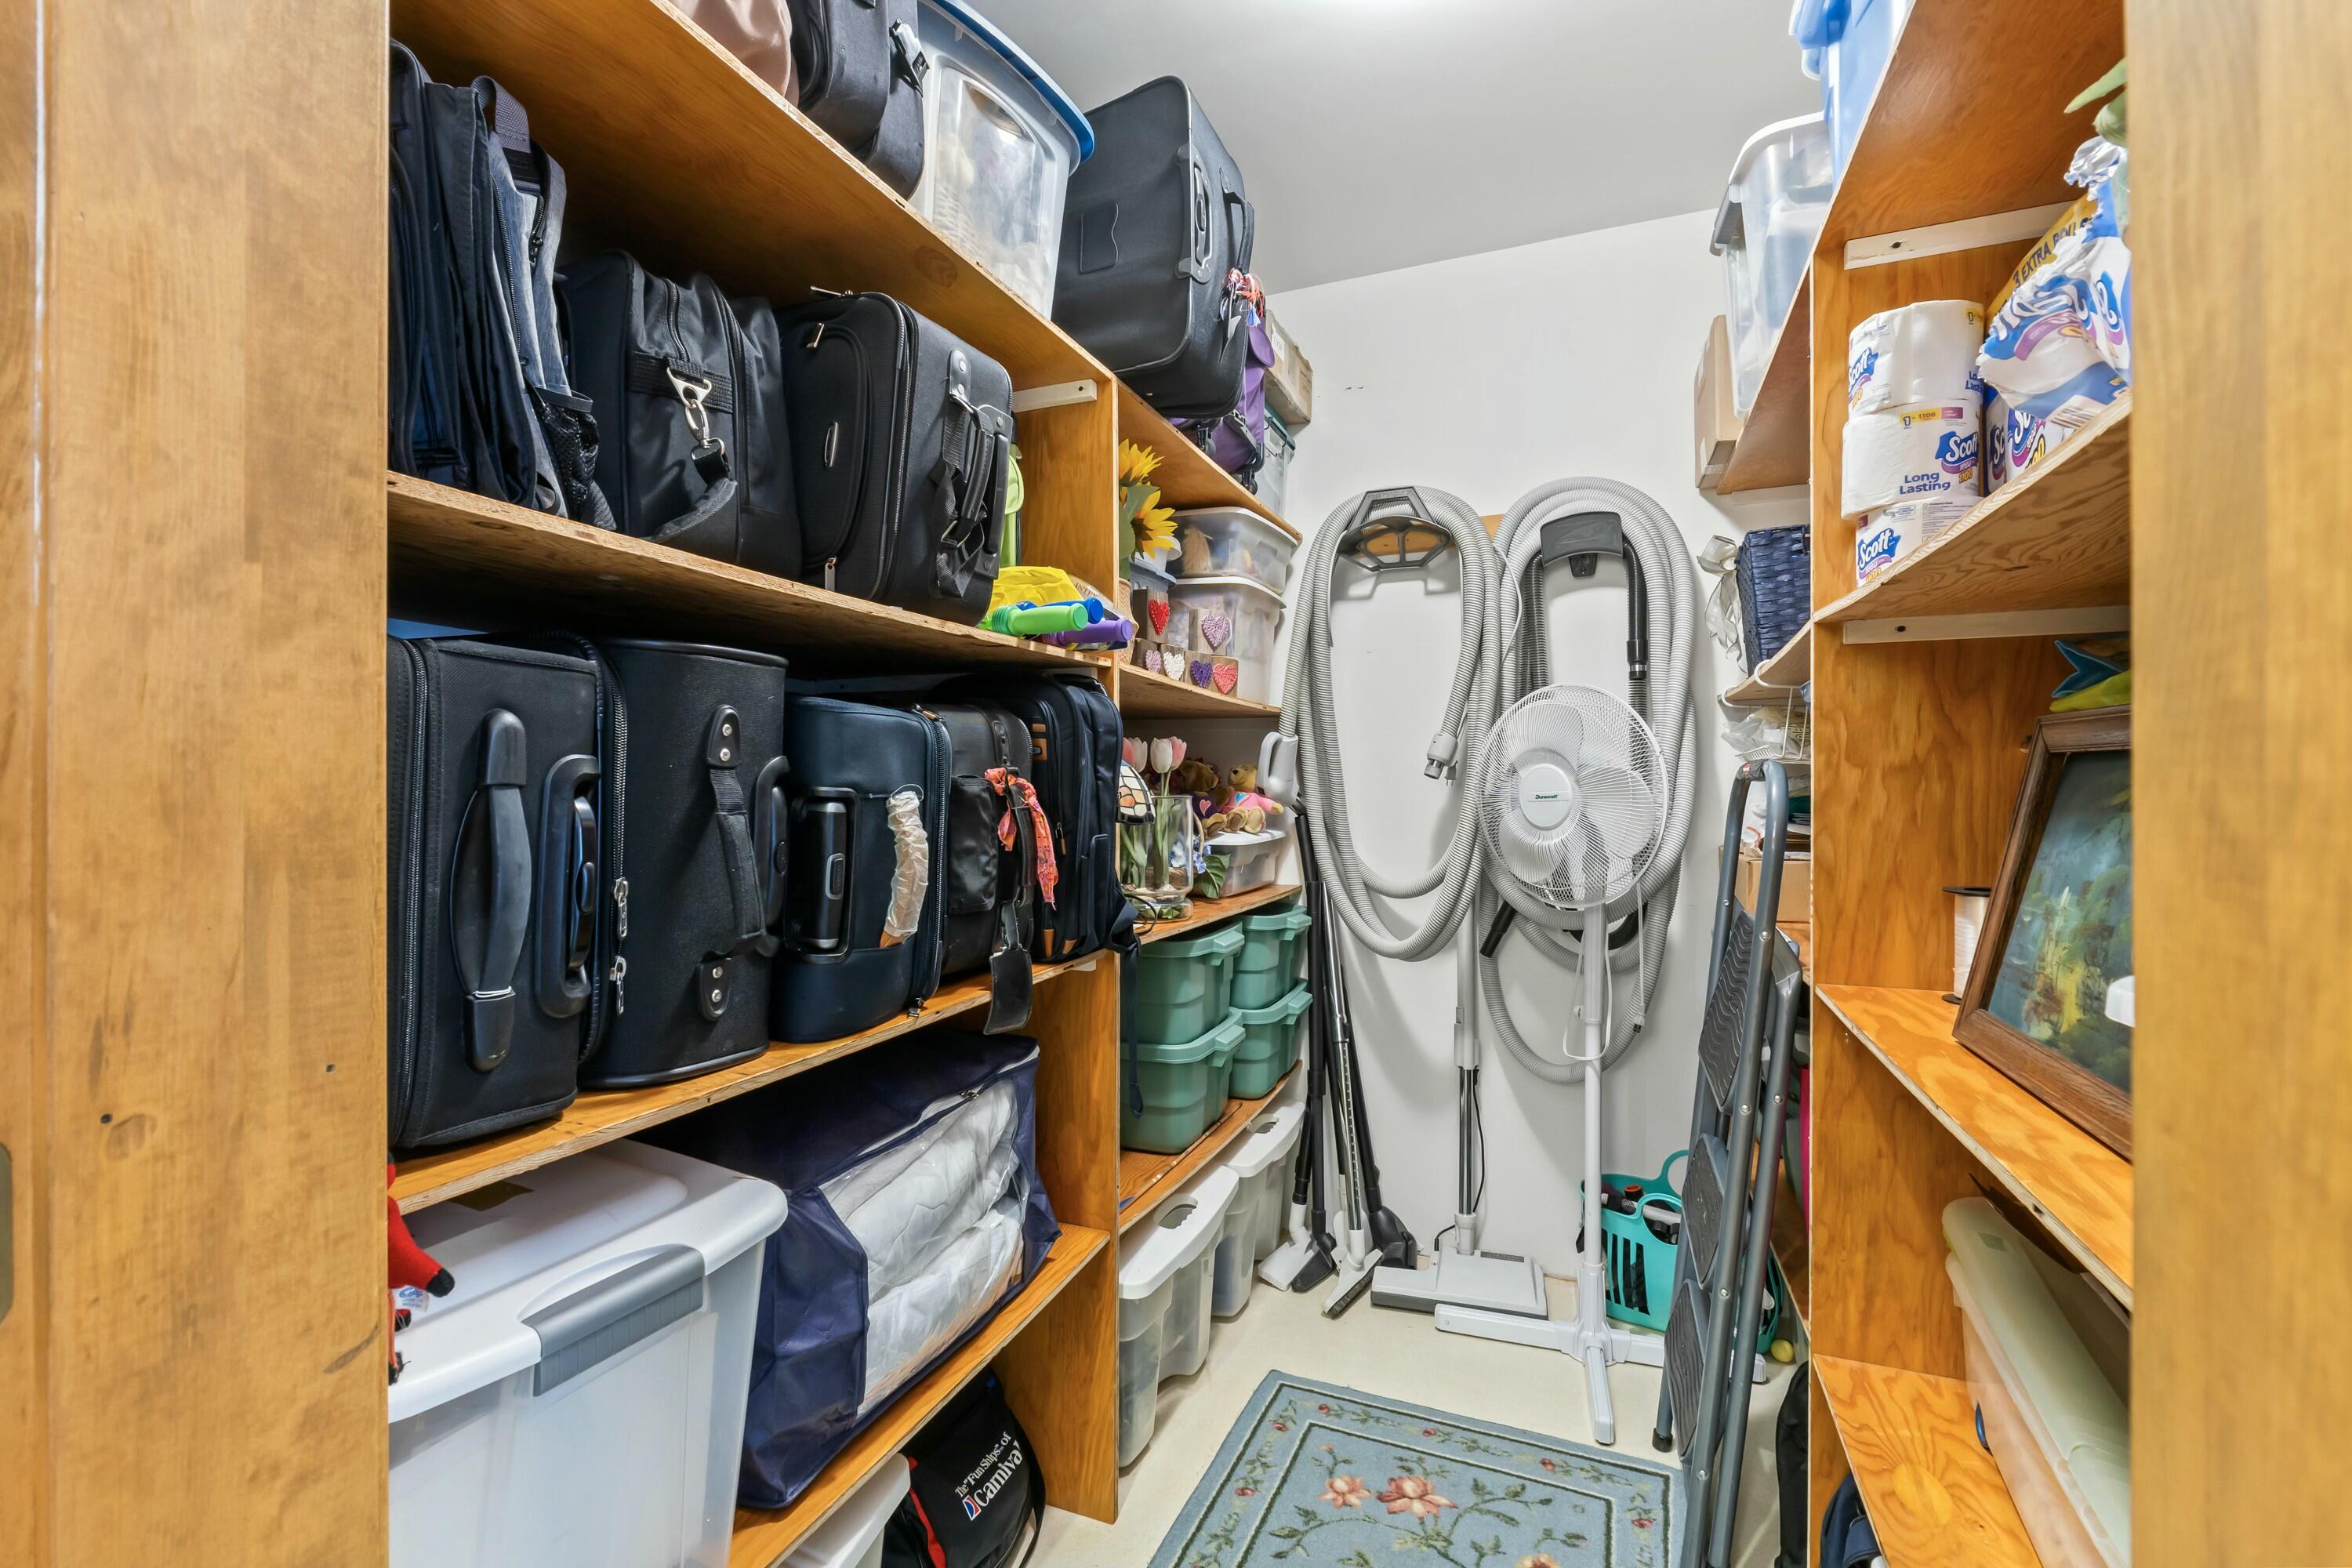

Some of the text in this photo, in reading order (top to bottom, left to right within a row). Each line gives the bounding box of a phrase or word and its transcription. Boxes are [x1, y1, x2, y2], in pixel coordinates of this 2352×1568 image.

[2021, 241, 2051, 282] EXTRA
[1904, 416, 1911, 426] 1
[1945, 432, 1978, 462] Scott
[1900, 481, 1951, 495] Lasting
[1904, 472, 1940, 484] Long
[1860, 529, 1890, 568] Scott
[955, 1485, 969, 1497] The
[1000, 1431, 1011, 1446] of
